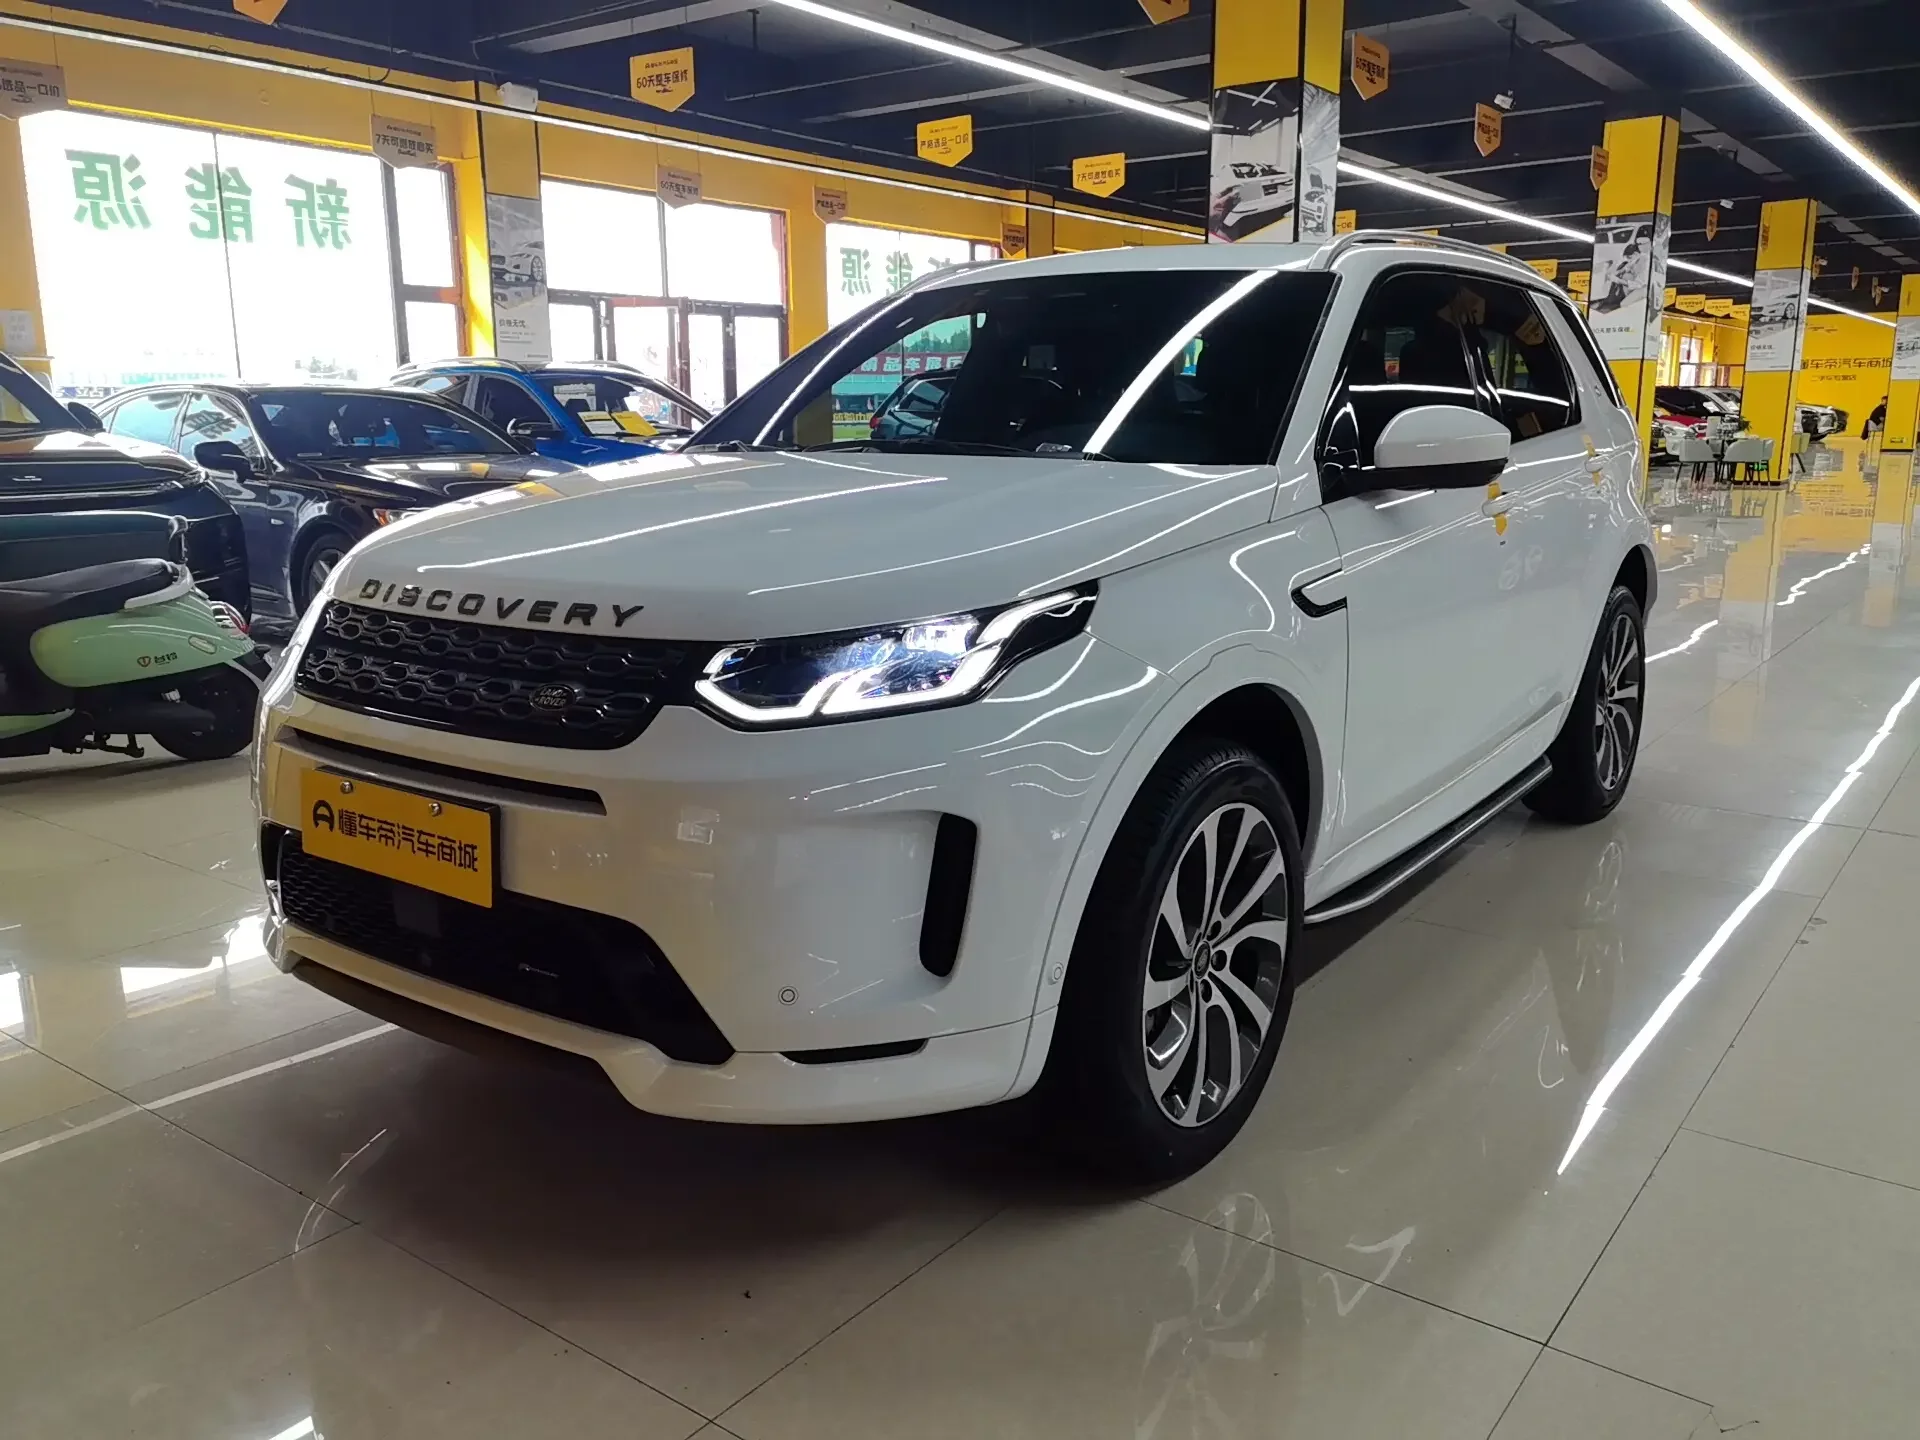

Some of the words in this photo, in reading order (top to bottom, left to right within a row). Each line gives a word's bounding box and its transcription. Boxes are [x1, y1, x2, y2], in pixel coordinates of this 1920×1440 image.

[0, 78, 60, 98] 选品一口价
[358, 578, 645, 628] DISCOVERY
[338, 808, 479, 873] 懂车帝汽车商城
